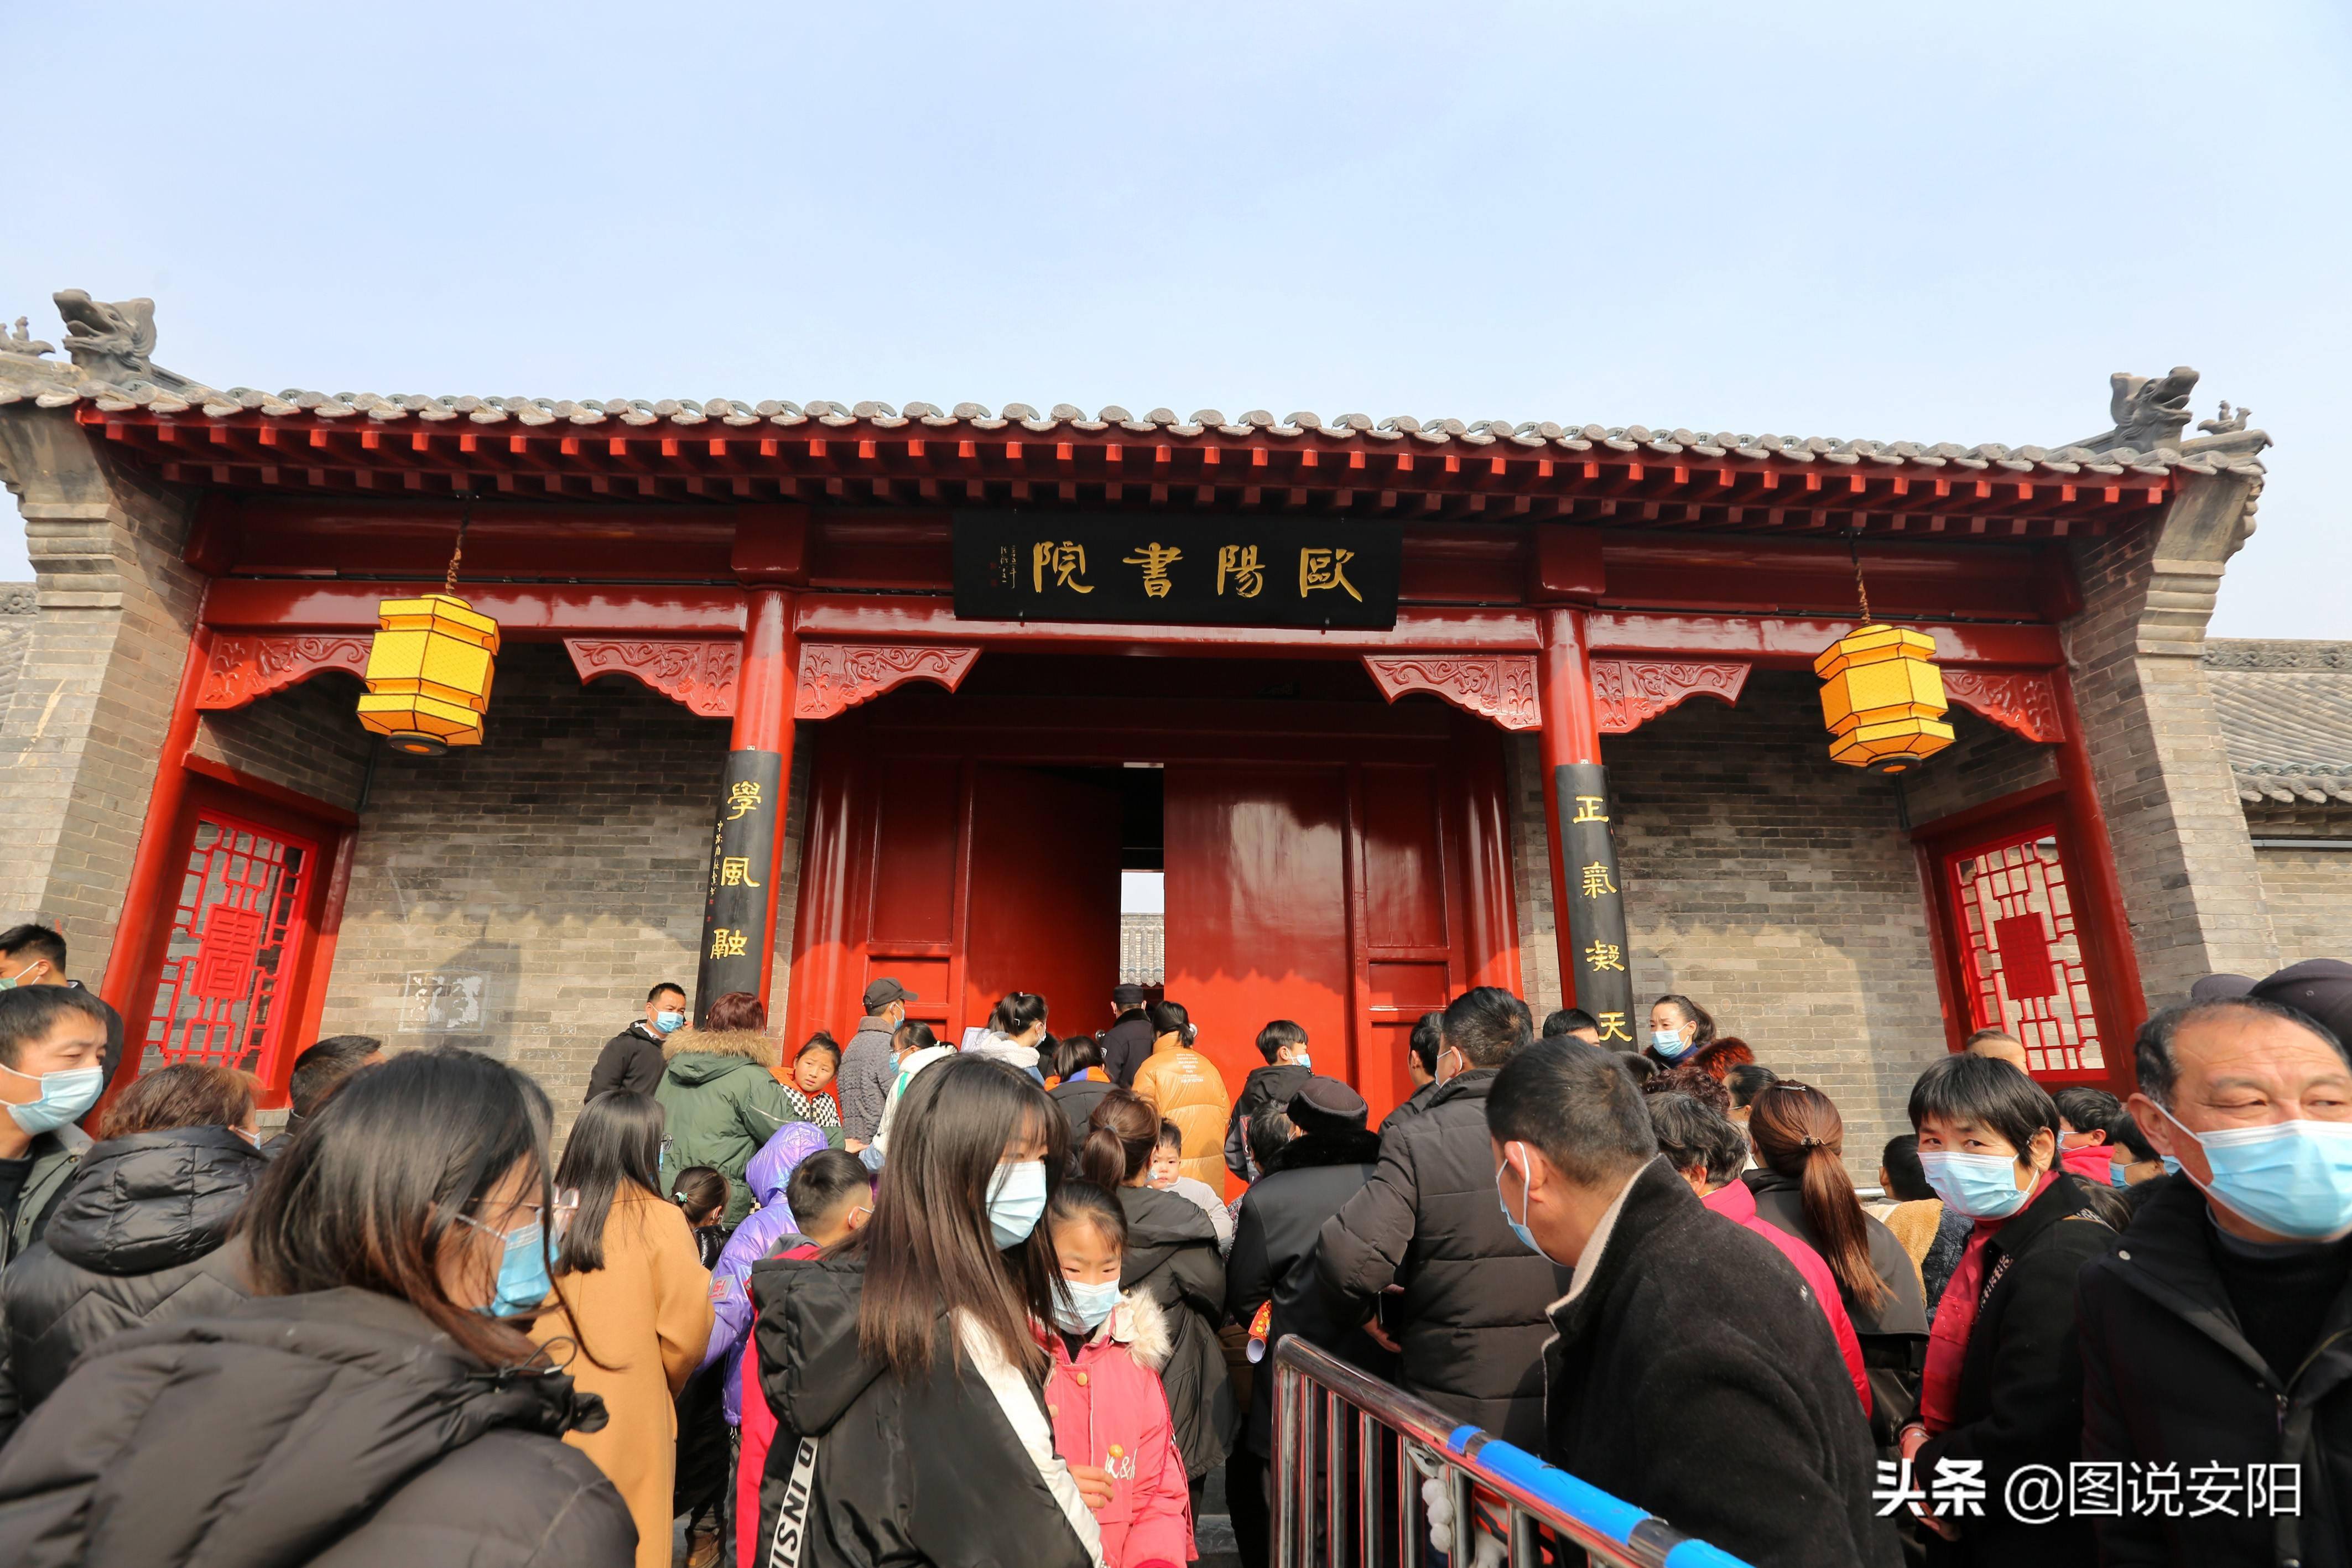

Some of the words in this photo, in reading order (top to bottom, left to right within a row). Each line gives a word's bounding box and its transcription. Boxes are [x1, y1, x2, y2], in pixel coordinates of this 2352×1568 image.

[705, 780, 762, 1020] 學風融
[1572, 794, 1633, 1043] 正氣凝天
[772, 1480, 807, 1568] INSI
